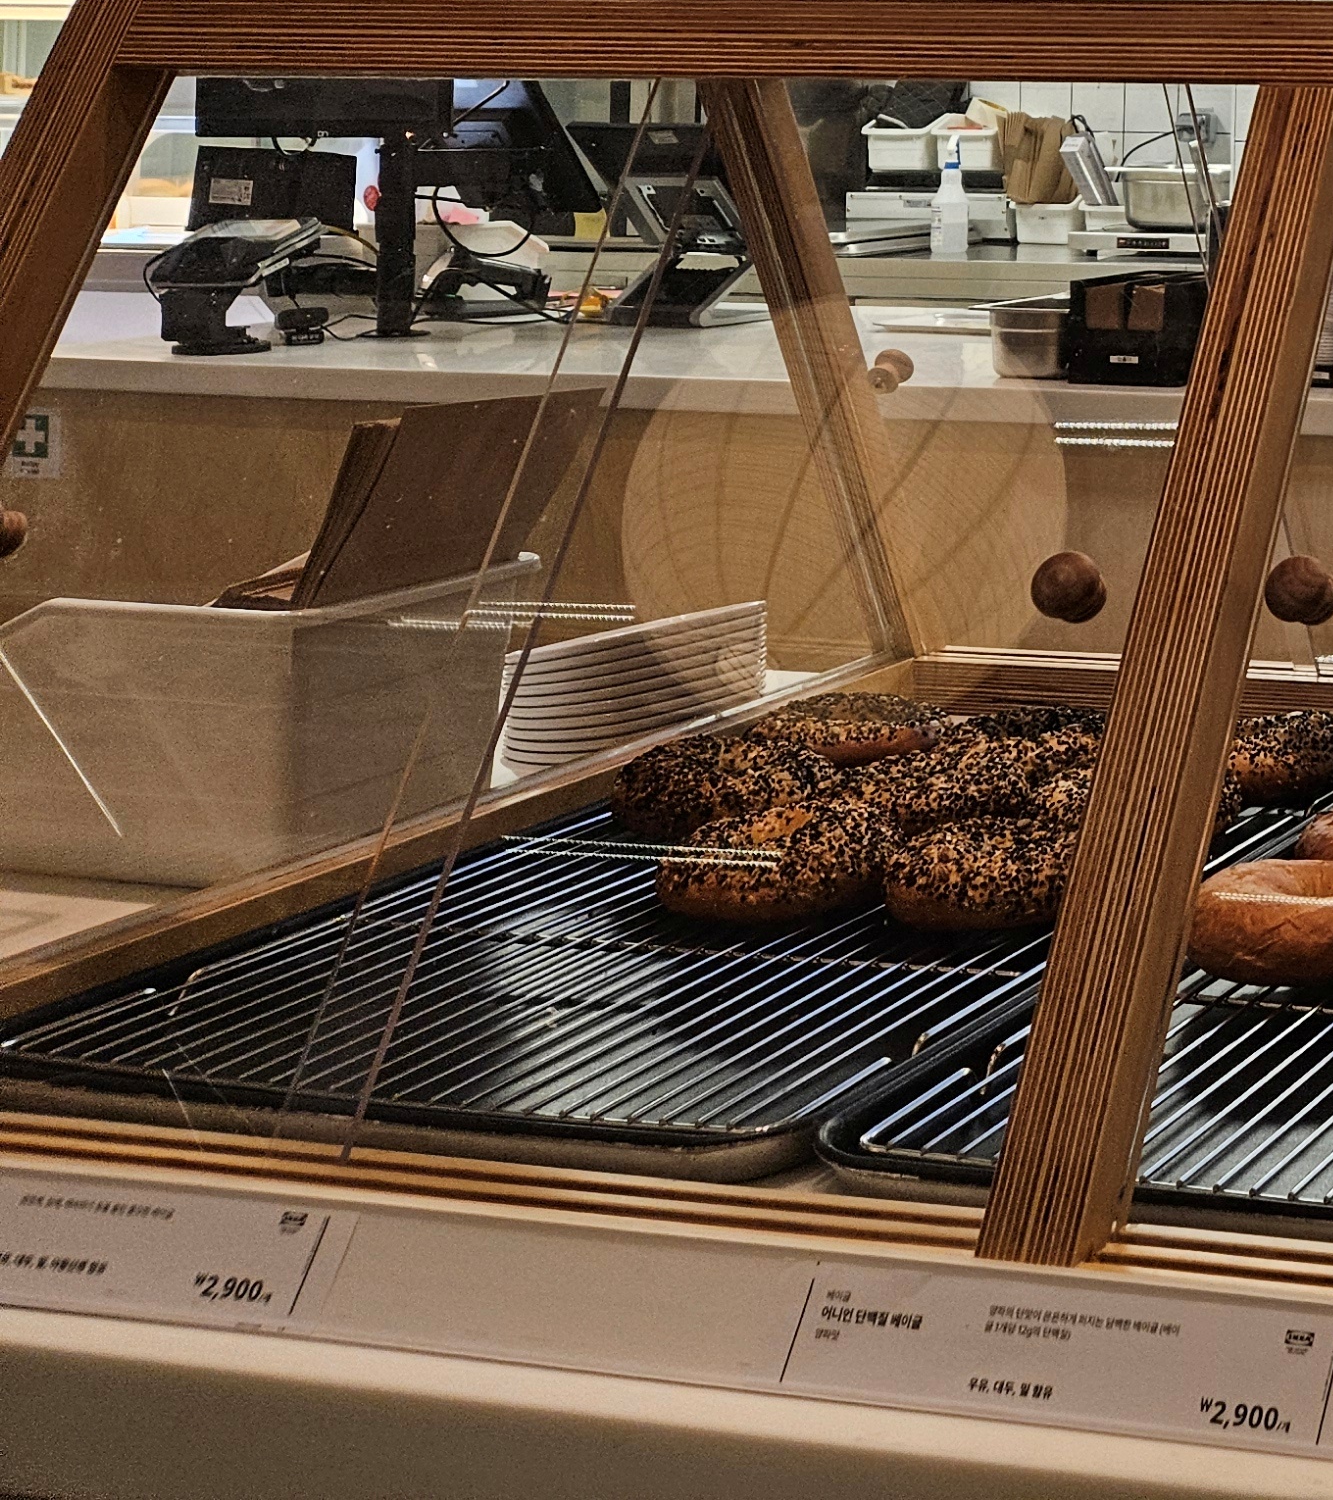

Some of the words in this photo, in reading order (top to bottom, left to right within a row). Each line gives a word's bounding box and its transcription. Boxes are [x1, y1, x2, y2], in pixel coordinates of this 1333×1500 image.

[821, 1305, 855, 1323] 어니언
[855, 1309, 890, 1327] 단백질
[890, 1313, 924, 1330] 베이글
